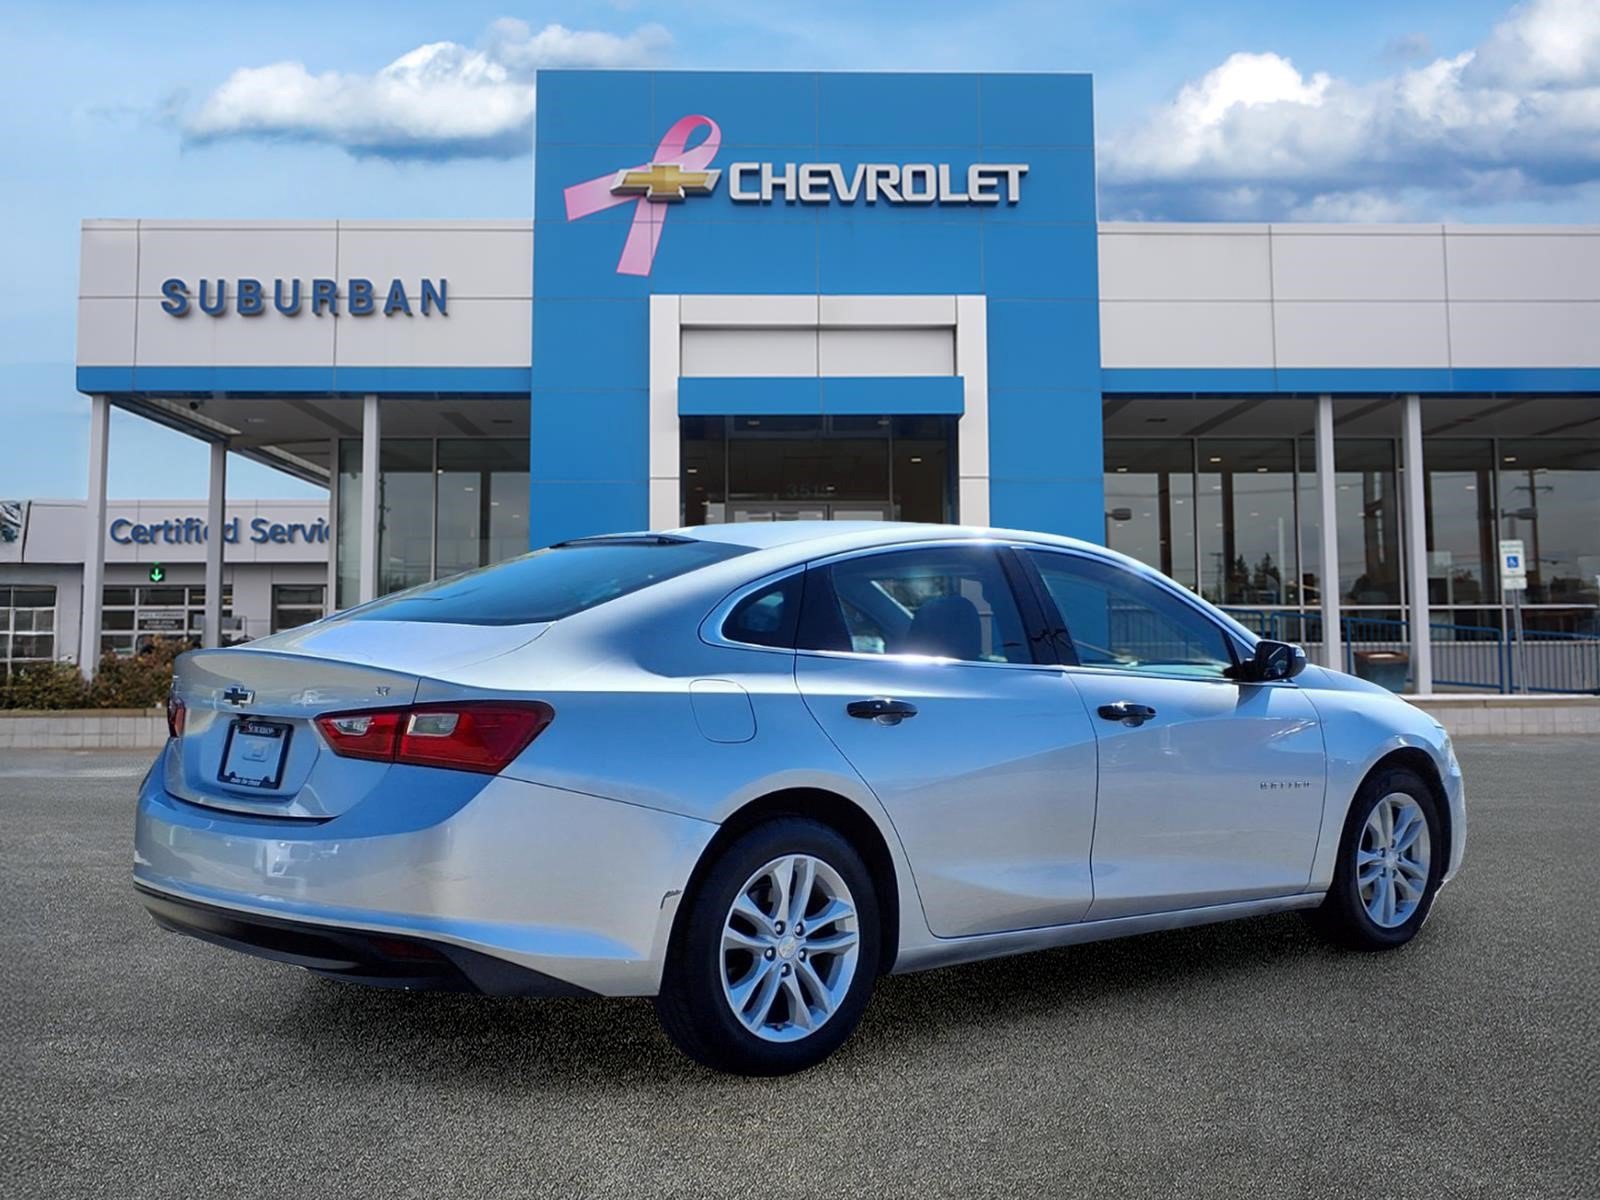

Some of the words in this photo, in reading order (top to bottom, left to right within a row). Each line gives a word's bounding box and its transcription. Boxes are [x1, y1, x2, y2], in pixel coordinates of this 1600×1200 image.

[729, 162, 1029, 205] CHEVROLET
[161, 278, 449, 316] SUBURBAN
[110, 518, 240, 544] Certifid
